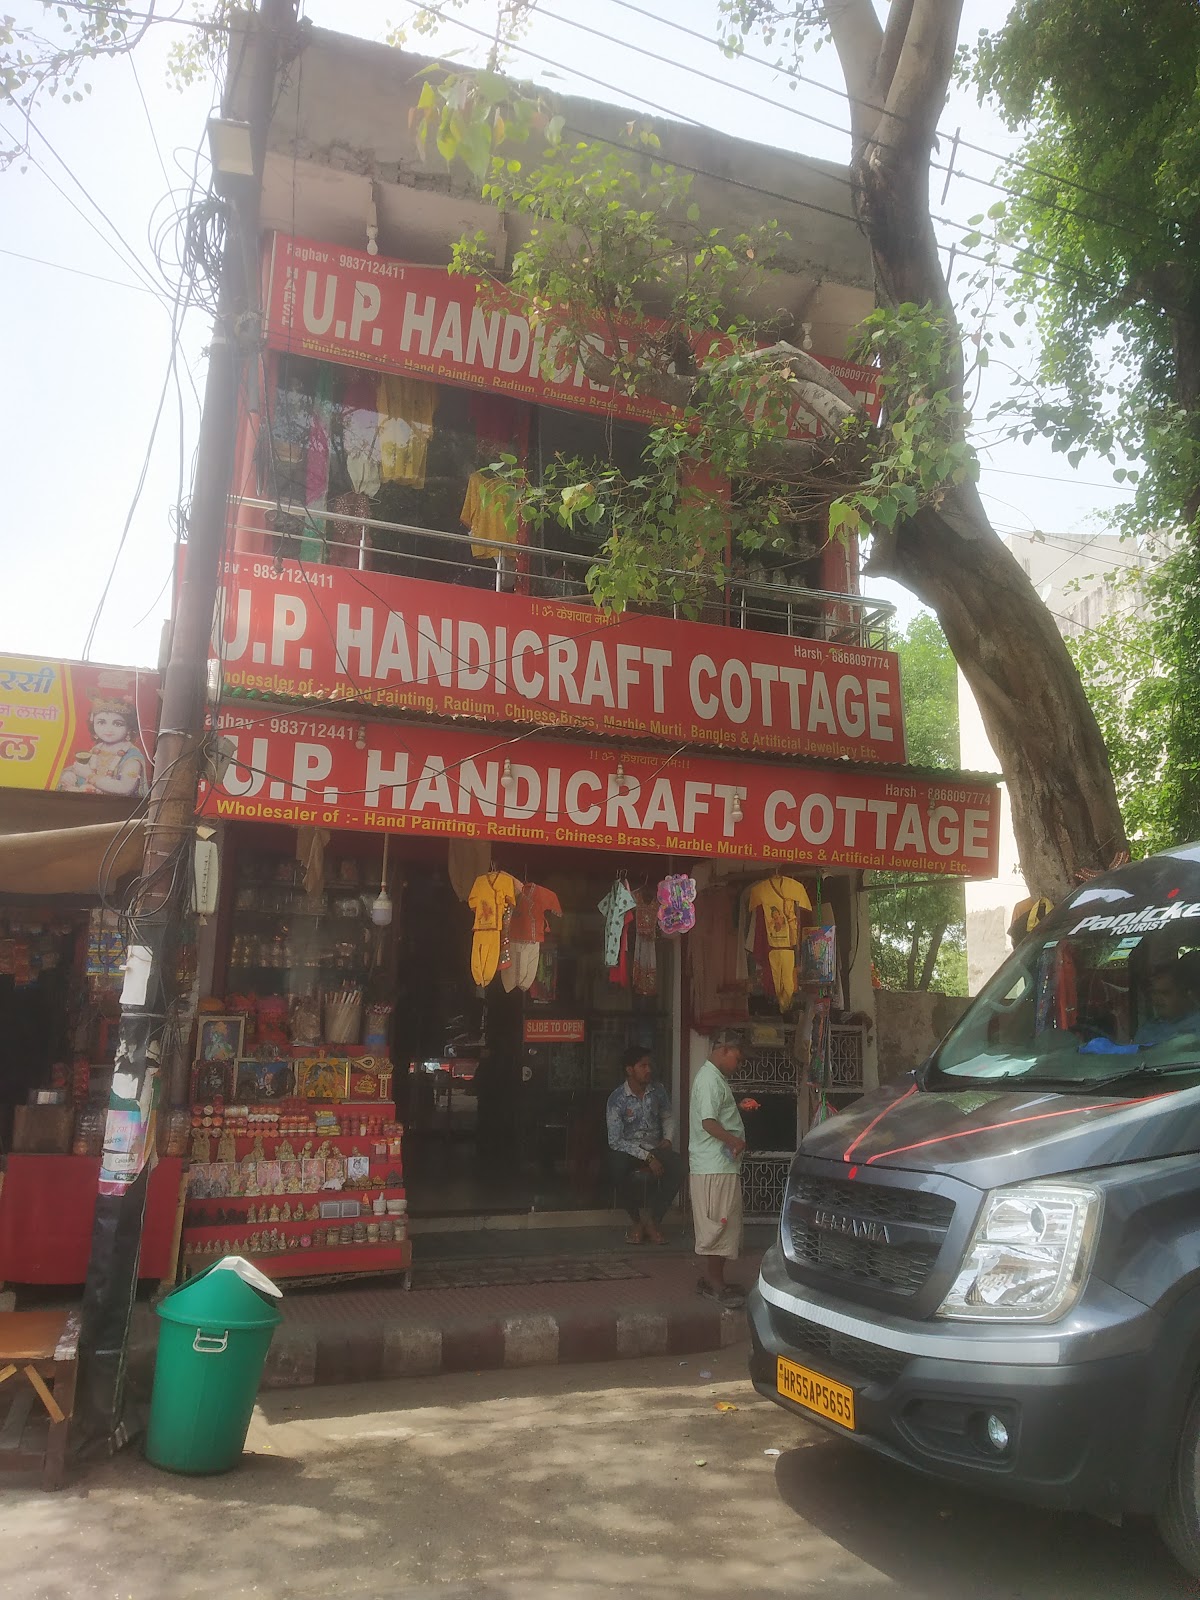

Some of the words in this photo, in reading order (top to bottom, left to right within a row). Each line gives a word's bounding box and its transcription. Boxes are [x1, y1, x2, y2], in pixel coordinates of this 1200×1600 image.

[339, 254, 405, 280] 9837124411
[303, 270, 383, 346] U.P.
[829, 364, 879, 384] 886809777
[493, 376, 538, 398] Radium,
[211, 586, 312, 670] U.P.
[335, 602, 672, 714] HANDICRAFT
[689, 653, 894, 742] COTTAGE
[794, 645, 822, 660] Harsh
[832, 652, 890, 670] 8868097774
[205, 713, 252, 731] aghav
[444, 695, 498, 717] Radium,
[650, 720, 687, 739] Murti,
[691, 725, 737, 744] Bangles
[753, 734, 801, 750] Artificial
[860, 746, 880, 759] Etc.
[222, 735, 338, 804] U.P.
[364, 749, 747, 838] HANDICRAFT
[763, 789, 990, 859] COTTAGE
[885, 784, 917, 798] Harsh
[216, 799, 317, 824] Wholesaler
[322, 810, 340, 824] of
[363, 812, 406, 829] Hand
[411, 816, 481, 837] Painting,
[487, 821, 550, 842] Radium,
[555, 827, 614, 845] Chinese
[617, 832, 661, 850] Brass,
[666, 835, 713, 853] Marble
[717, 841, 758, 857] Murti,
[762, 845, 813, 862] Bangles
[817, 849, 828, 861] &
[831, 849, 885, 867] Artificial
[888, 855, 946, 873] Jewellery
[949, 859, 971, 873] Etc.
[1109, 920, 1171, 936] TOURIST
[526, 1022, 549, 1032] SLIDE
[551, 1022, 561, 1032] TO
[562, 1022, 583, 1032] OPEN
[783, 1367, 851, 1420] HR55AP5655
